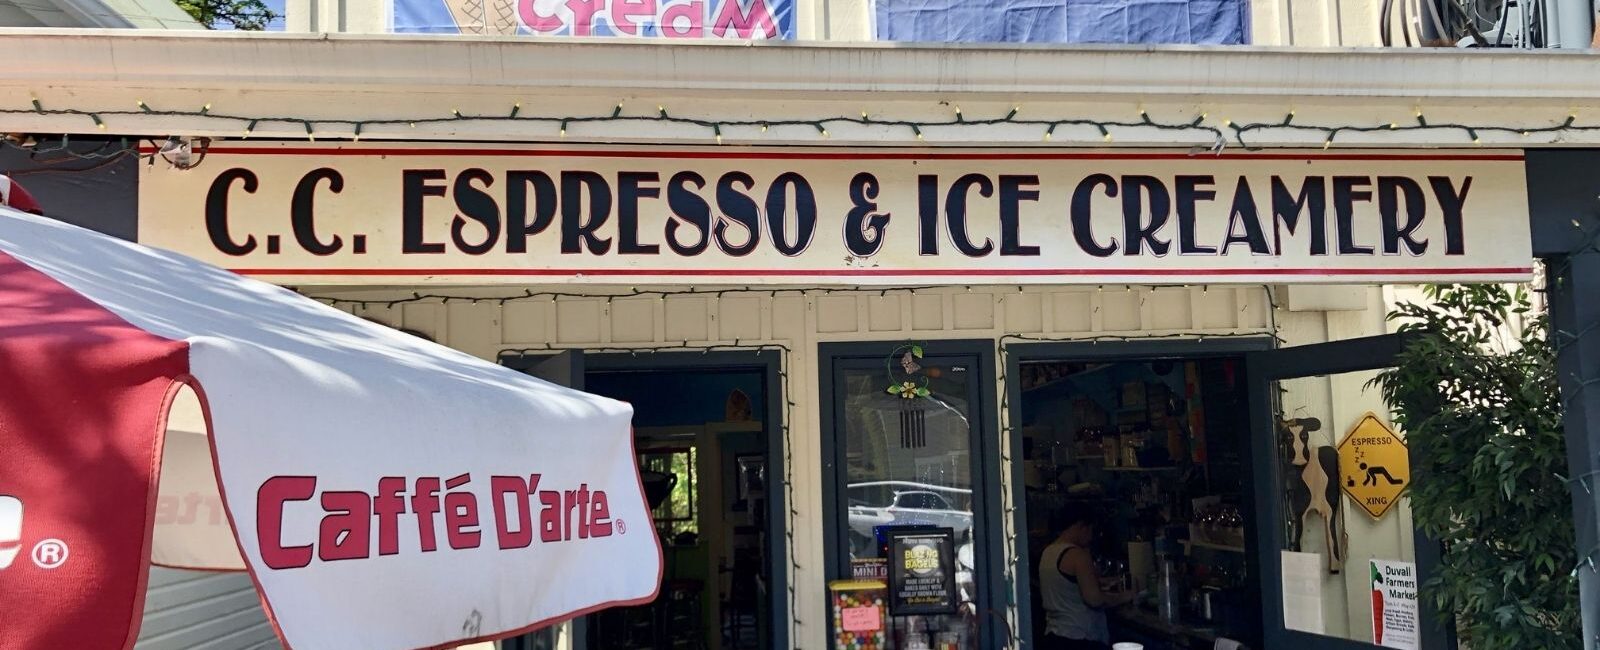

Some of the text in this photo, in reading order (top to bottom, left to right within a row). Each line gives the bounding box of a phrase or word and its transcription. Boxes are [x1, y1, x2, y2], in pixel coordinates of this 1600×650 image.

[204, 167, 1472, 258] C.C. ESPRESSO & ICE CREAMERY
[1351, 436, 1392, 446] ESPRESSO
[1366, 497, 1388, 505] XING
[256, 473, 482, 570] Caffé
[491, 473, 613, 549] D'arte
[905, 559, 939, 569] BAGELS
[853, 567, 877, 577] MINI
[1385, 565, 1411, 577] Duvall
[1385, 577, 1415, 588] Farmers
[1389, 589, 1415, 600] Market
